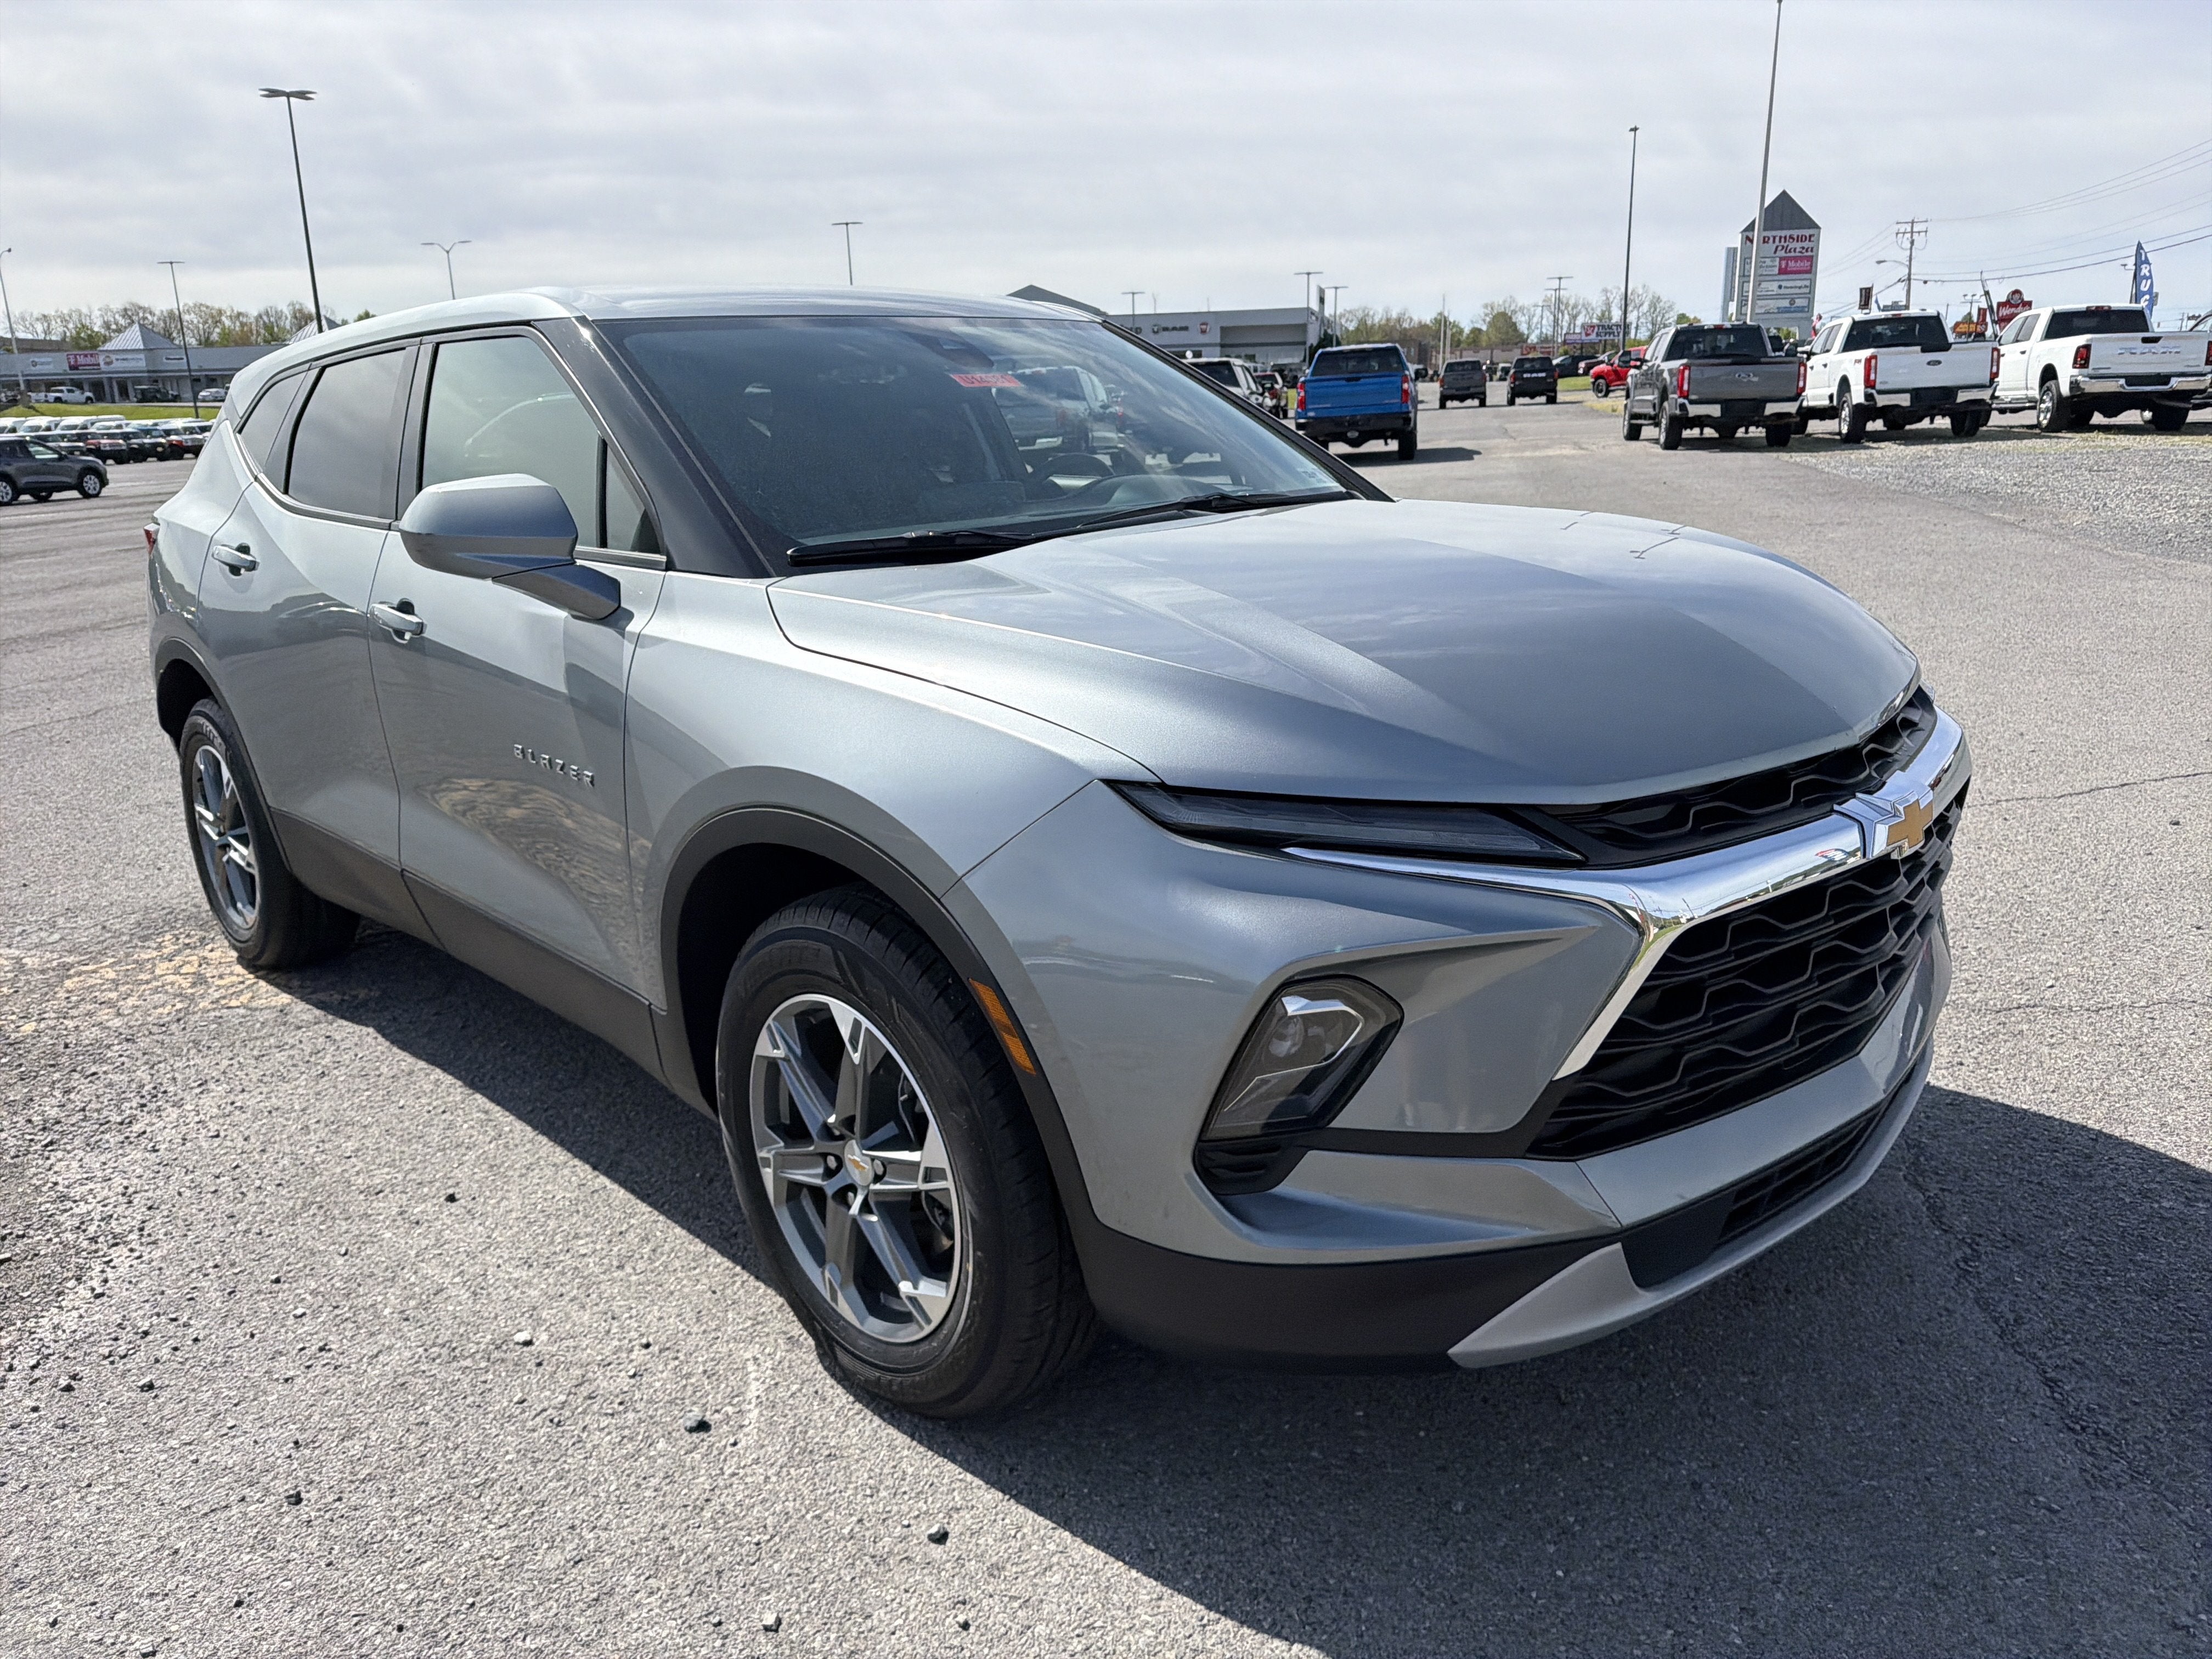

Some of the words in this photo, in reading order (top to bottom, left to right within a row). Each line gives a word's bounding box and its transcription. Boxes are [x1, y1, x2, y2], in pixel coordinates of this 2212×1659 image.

[1745, 233, 1815, 245] NRTHSIDE
[1773, 244, 1814, 255] Plaza
[1788, 259, 1810, 268] Mobile
[514, 743, 595, 788] BLAZER
